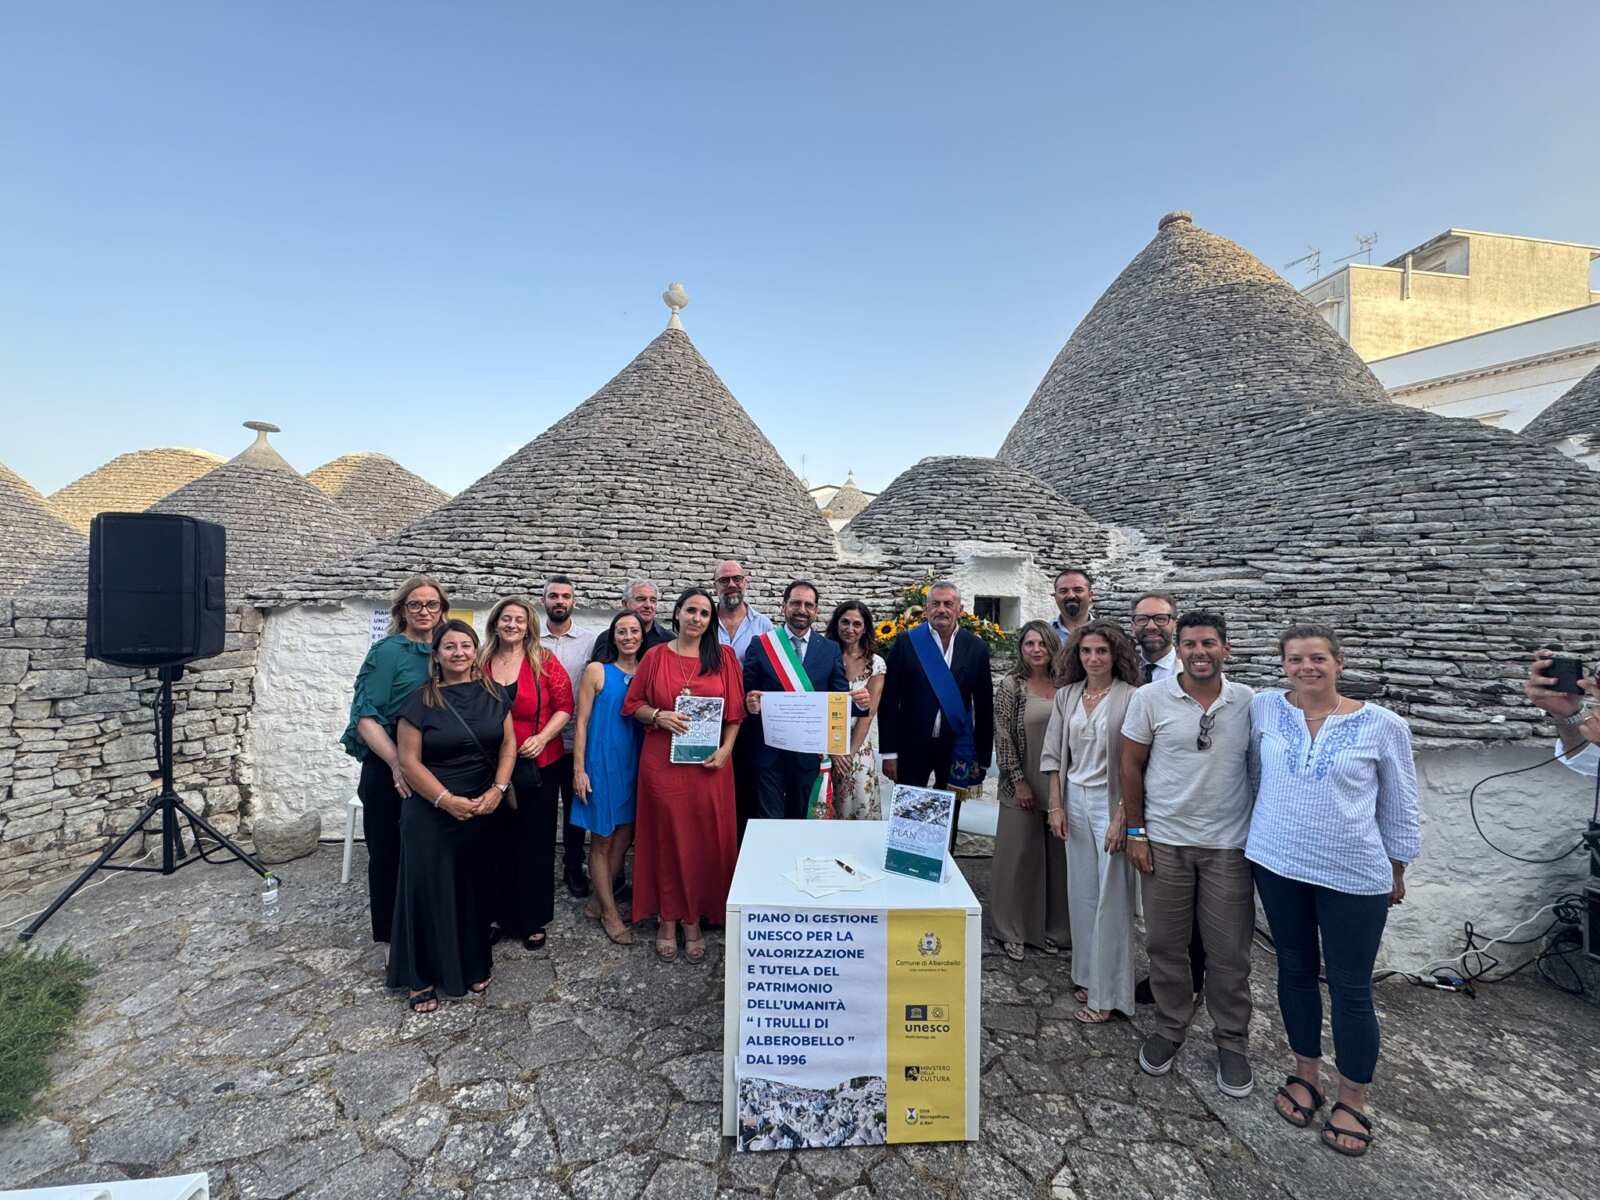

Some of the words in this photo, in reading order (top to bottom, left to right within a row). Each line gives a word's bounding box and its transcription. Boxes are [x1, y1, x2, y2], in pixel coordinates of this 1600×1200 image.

[748, 913, 791, 923] PIANO
[795, 914, 809, 923] DI
[812, 914, 879, 924] GESTIONE
[747, 930, 803, 941] UNESCO
[806, 931, 833, 941] PER
[836, 931, 854, 941] LA
[747, 948, 865, 959] VALORIZZAZIONE
[747, 964, 756, 974] E
[759, 965, 810, 976] TUTELA
[813, 966, 840, 976] DEL
[747, 981, 833, 993] PATRIMONIO
[765, 1018, 810, 1028] TRULLI
[814, 1018, 829, 1028] DI
[905, 1024, 950, 1033] unesco
[746, 1036, 845, 1046] ALBEROBELLO
[746, 1054, 774, 1065] DAL
[777, 1054, 807, 1065] 1996
